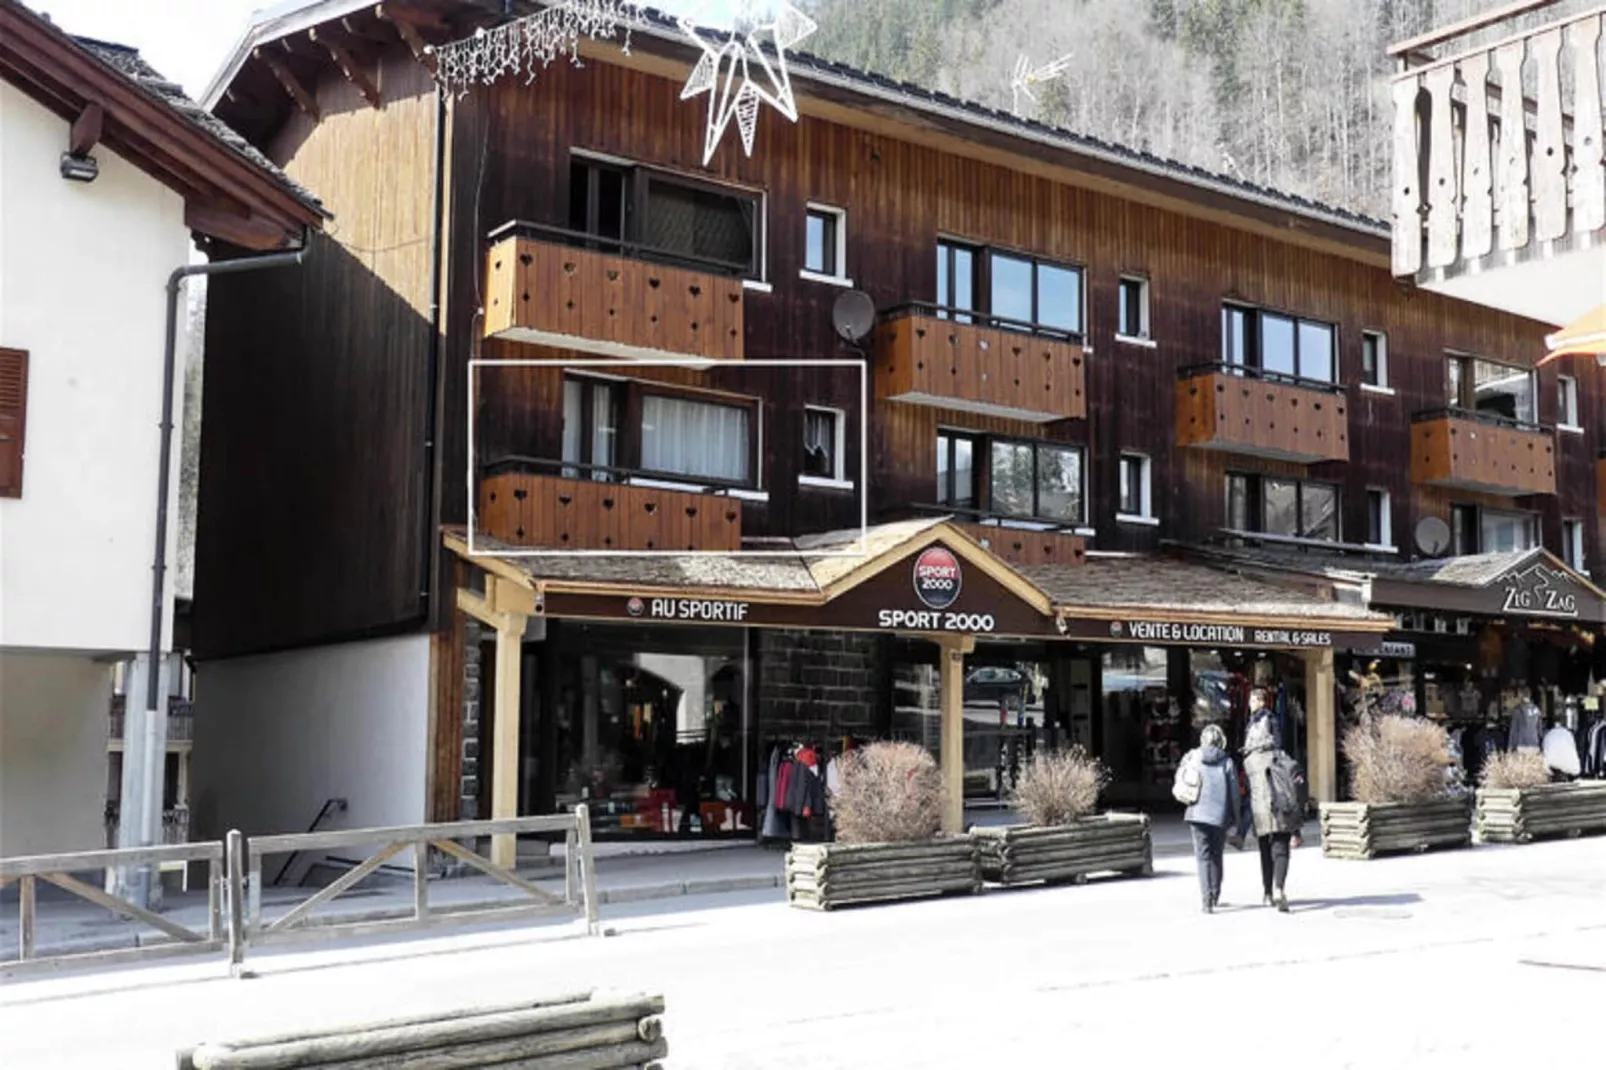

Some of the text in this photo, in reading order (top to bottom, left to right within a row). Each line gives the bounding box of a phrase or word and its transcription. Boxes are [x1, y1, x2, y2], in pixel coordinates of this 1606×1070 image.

[918, 566, 956, 578] SPORT
[922, 578, 953, 590] 2000
[651, 599, 676, 618] AU
[678, 600, 750, 620] SPORTIF
[1503, 587, 1576, 612] ZIG ZAG
[878, 609, 995, 631] SPORT 2000
[1129, 622, 1171, 638] VENTE
[1183, 625, 1244, 642] LOCATION
[1255, 630, 1290, 644] RENTAL
[1301, 632, 1331, 645] SALES
